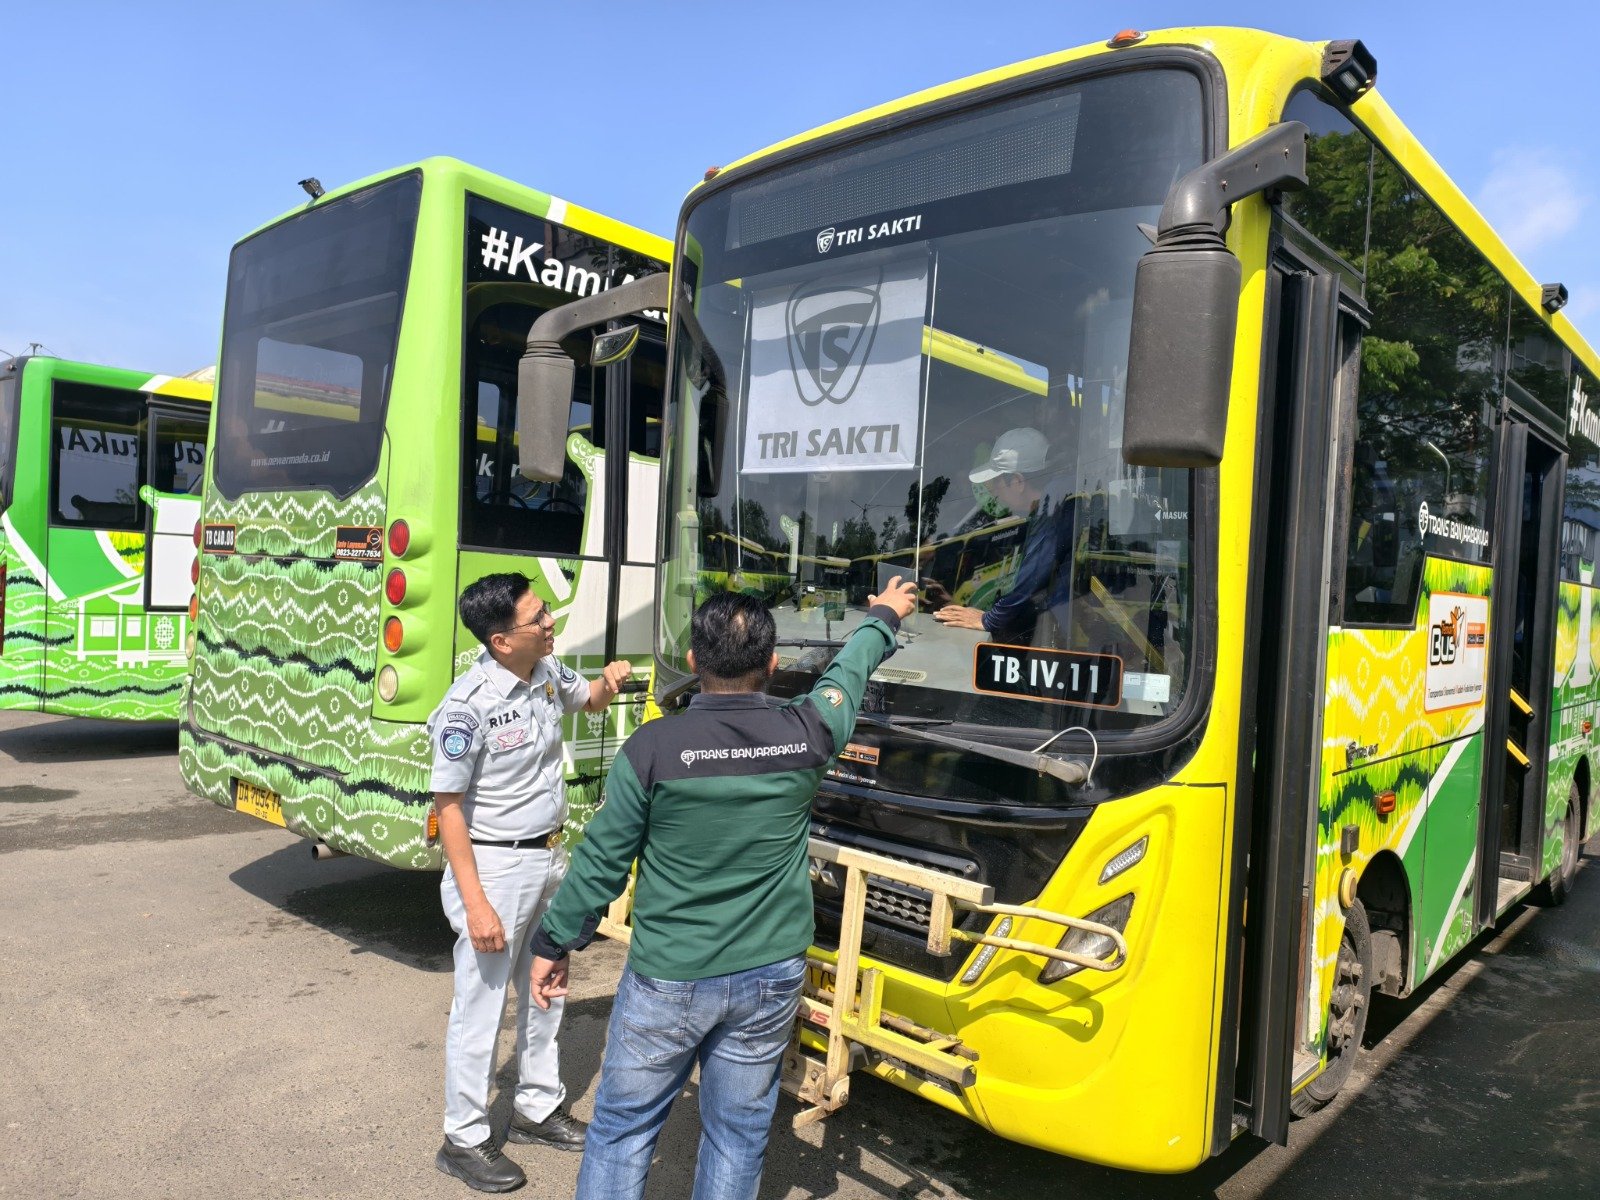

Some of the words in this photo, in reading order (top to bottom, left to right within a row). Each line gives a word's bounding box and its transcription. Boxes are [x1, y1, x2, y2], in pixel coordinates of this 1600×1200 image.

[836, 227, 864, 246] TRI
[867, 214, 922, 240] SAKTI
[757, 430, 798, 460] TRI
[805, 423, 900, 457] SAKTI
[251, 450, 331, 467] www.newarmada.co.id
[1162, 511, 1188, 520] MASUK
[1428, 514, 1450, 538] TRANS
[206, 530, 213, 546] TB
[336, 548, 381, 558] 0823-2277-7634
[991, 655, 1020, 684] TB
[1030, 659, 1099, 694] IV.11
[489, 709, 521, 728] RIZA
[694, 749, 729, 760] TRANS
[731, 742, 808, 759] BANJARBAKULA
[238, 782, 249, 802] DA
